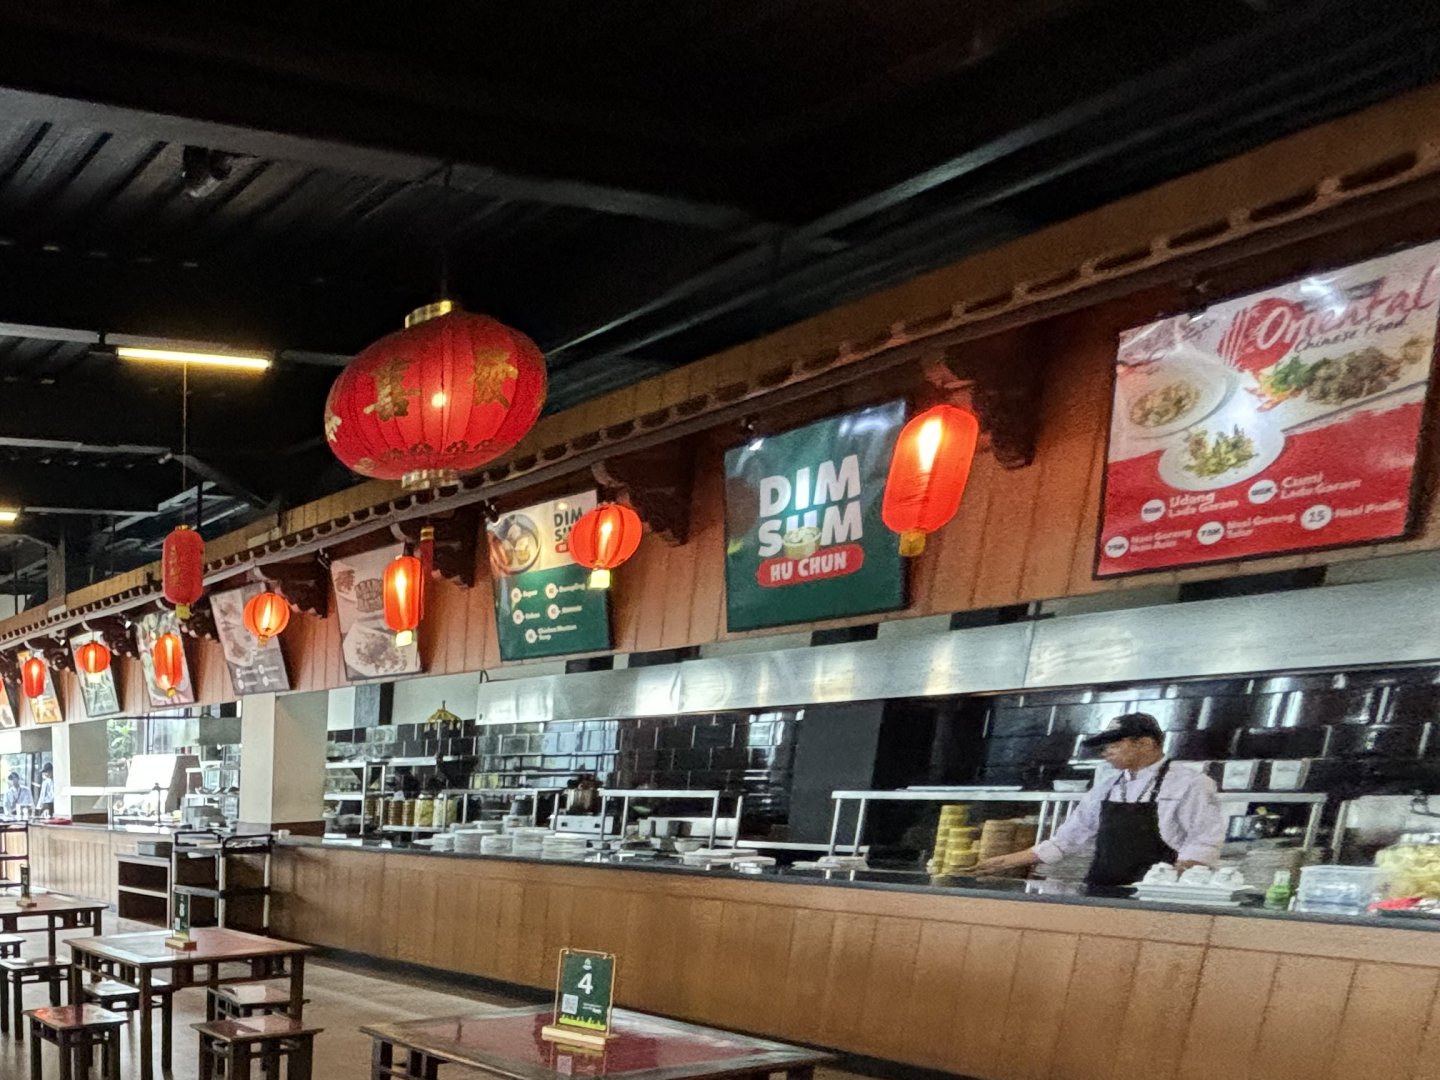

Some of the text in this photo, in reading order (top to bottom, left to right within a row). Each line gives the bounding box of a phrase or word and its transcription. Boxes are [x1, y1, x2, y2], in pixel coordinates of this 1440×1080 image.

[1295, 314, 1409, 353] Chinese Food
[760, 454, 861, 518] DIM
[1169, 492, 1216, 508] Udang
[554, 507, 583, 527] DIM
[770, 551, 847, 582] HU CHUN
[577, 972, 594, 995] 4
